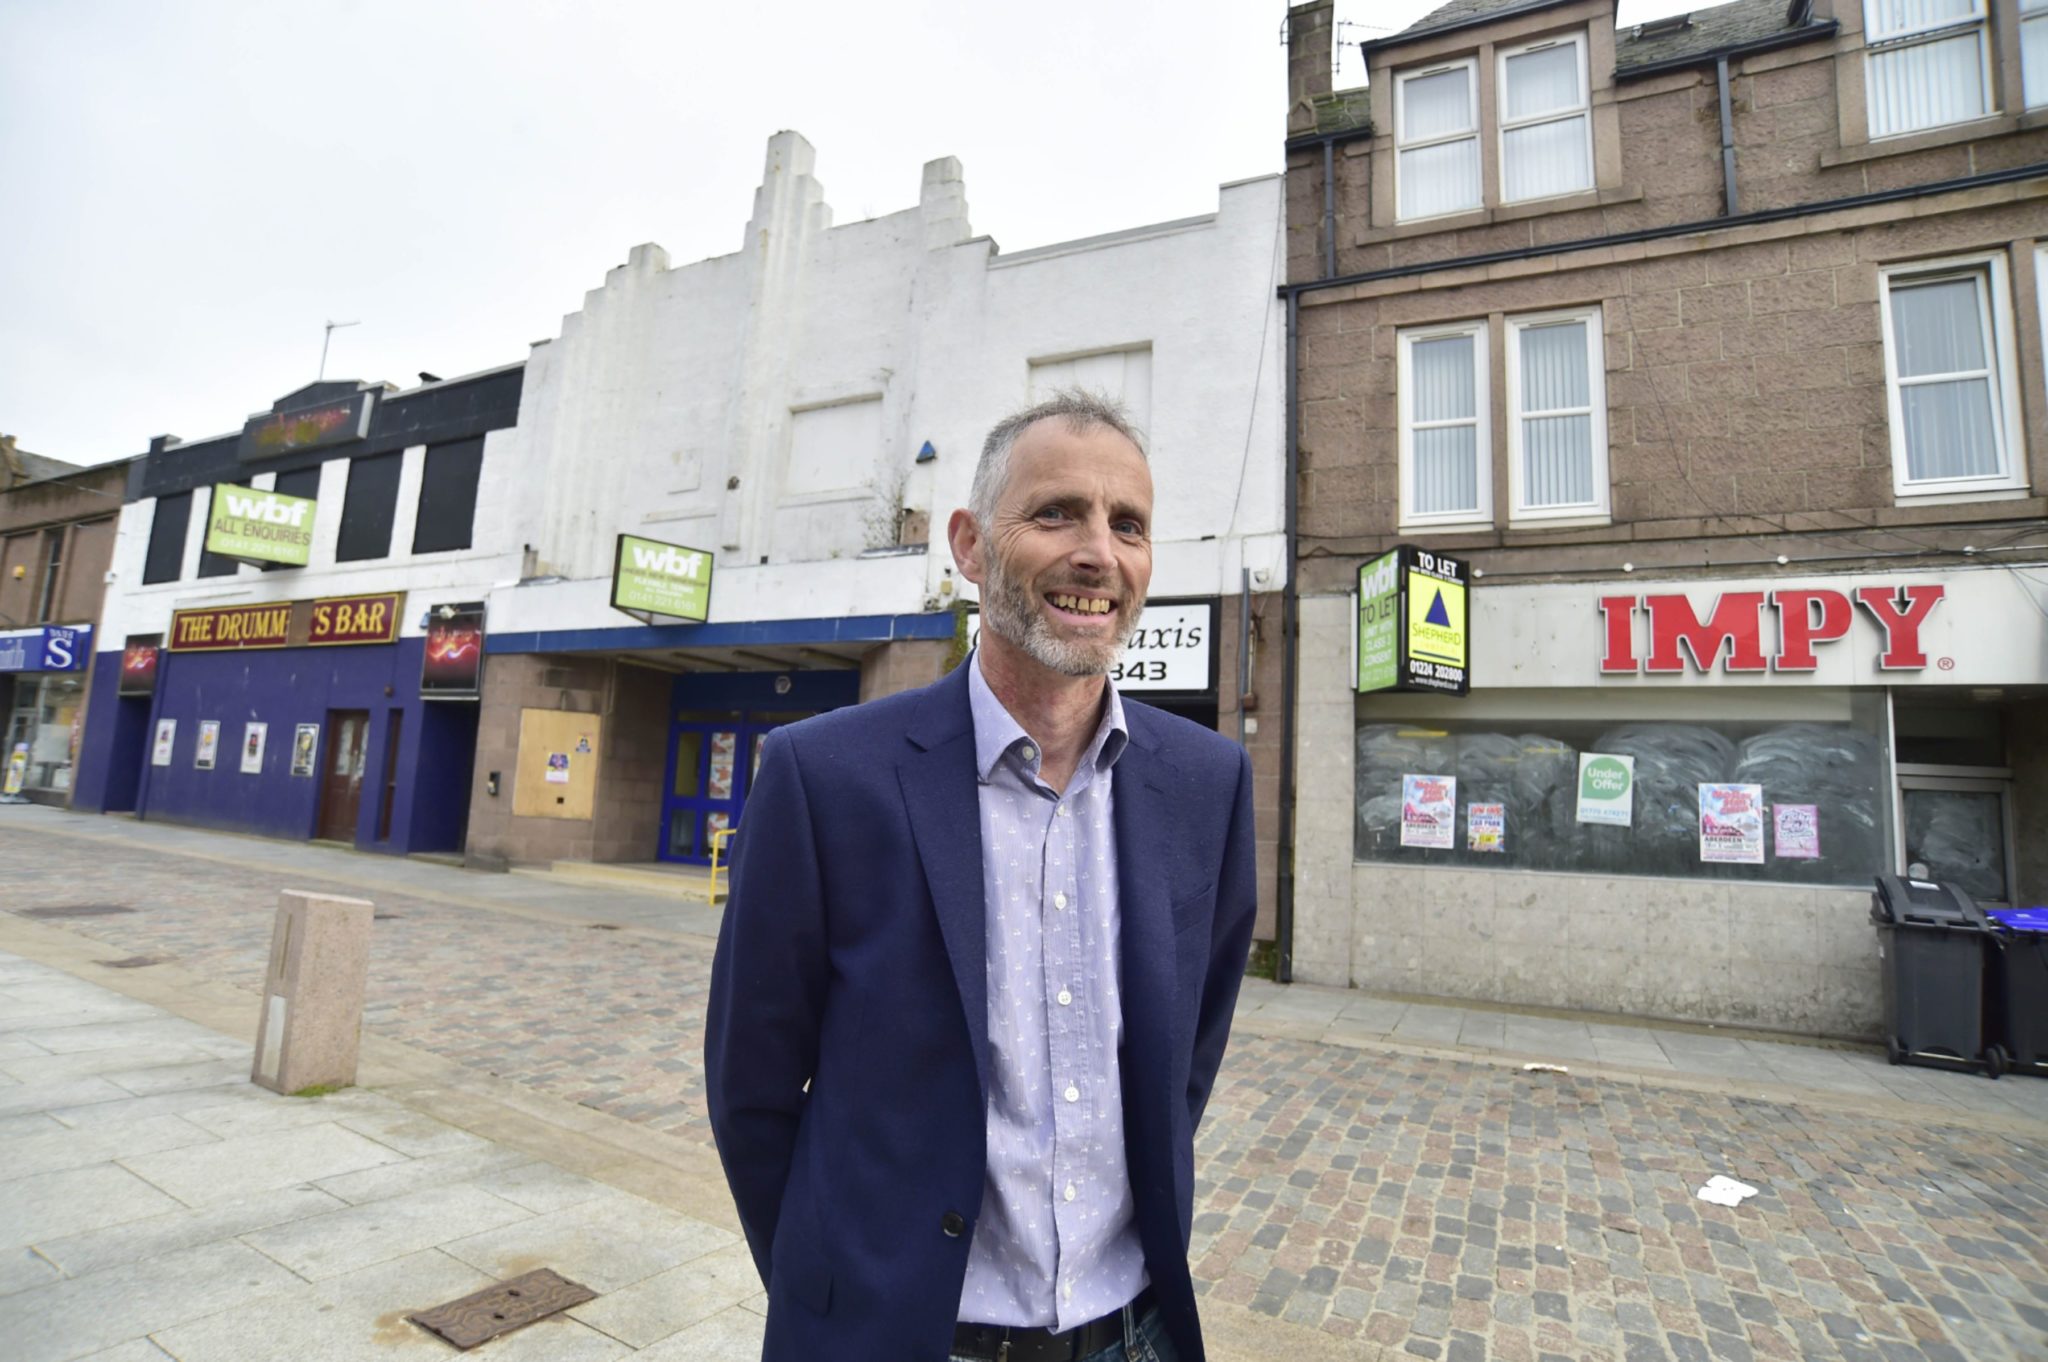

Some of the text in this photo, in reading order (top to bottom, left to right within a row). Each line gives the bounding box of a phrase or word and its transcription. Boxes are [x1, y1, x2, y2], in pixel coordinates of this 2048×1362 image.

[226, 494, 308, 526] wbf
[214, 518, 311, 546] ALL ENQUIRIES
[632, 545, 703, 579] wbf
[1361, 550, 1398, 600] wbf
[1418, 551, 1457, 577] TO LET
[179, 615, 214, 642] THE
[334, 602, 386, 634] BAR
[1360, 594, 1397, 625] TO LET
[1127, 617, 1202, 649] axis
[1412, 622, 1461, 645] SHEPHERD
[1599, 585, 1946, 673] IMPY
[1410, 659, 1434, 676] 01224
[1587, 767, 1624, 780] Under
[1592, 778, 1624, 791] Offer
